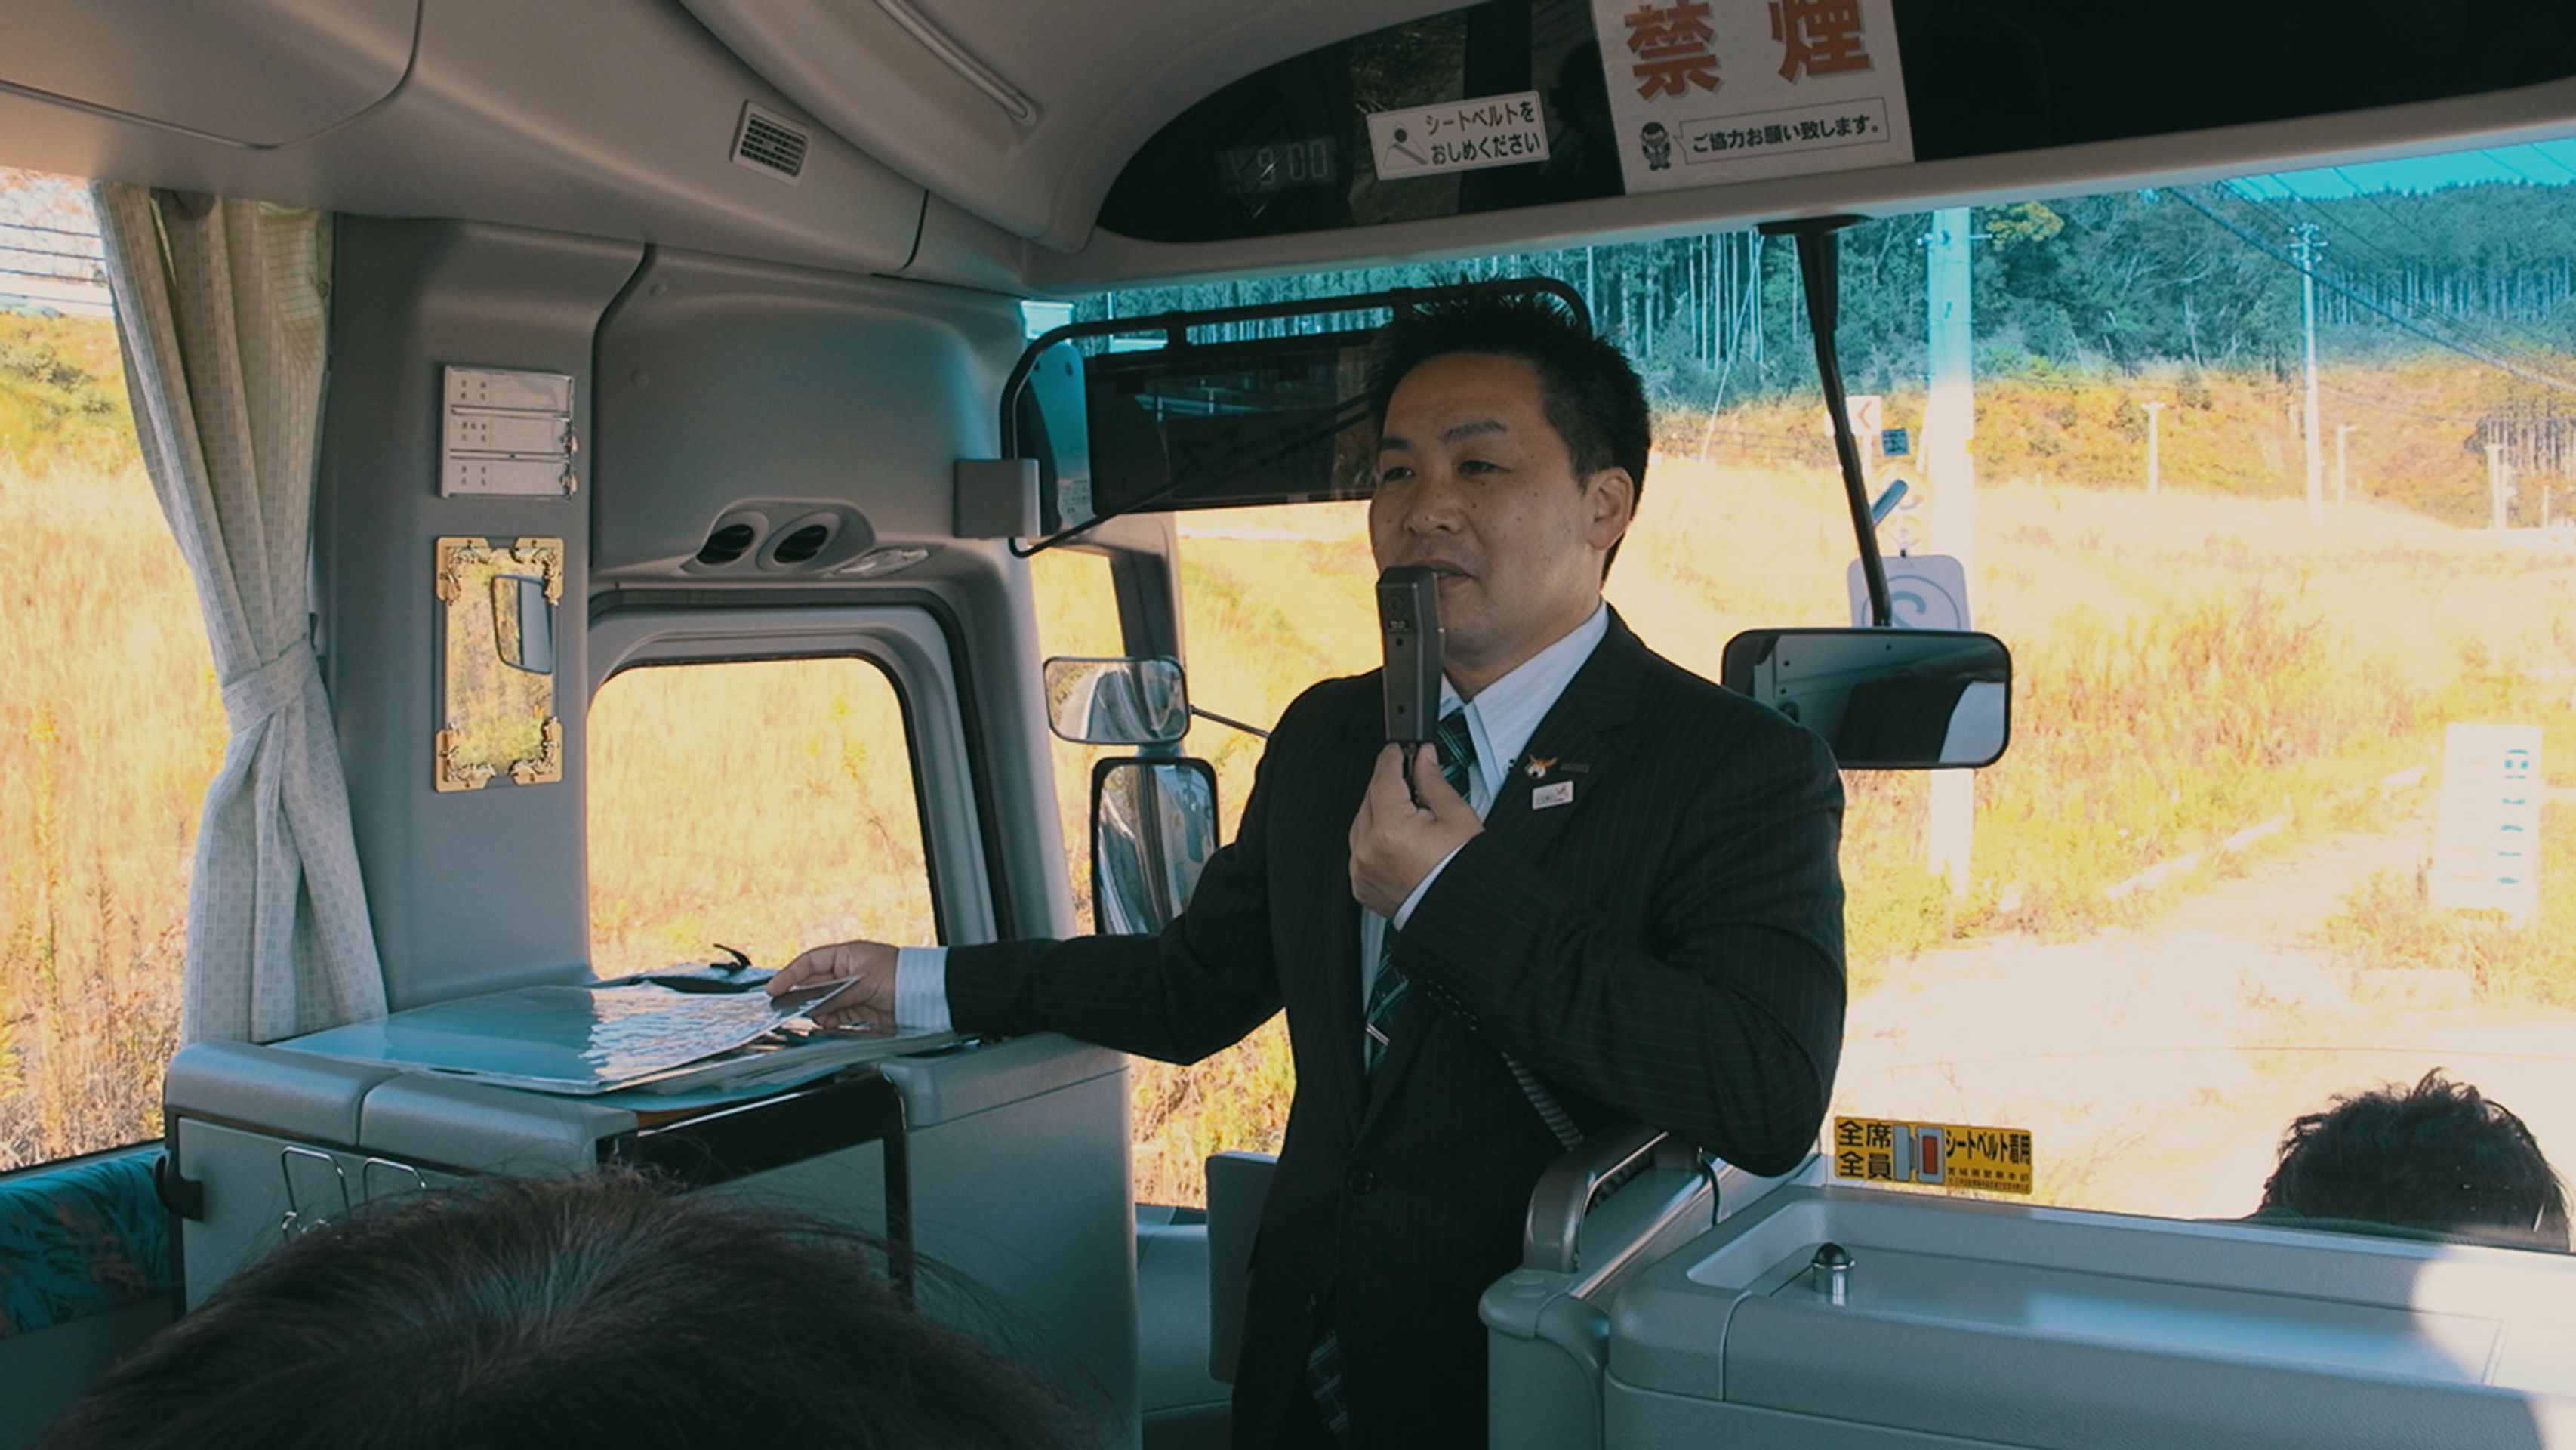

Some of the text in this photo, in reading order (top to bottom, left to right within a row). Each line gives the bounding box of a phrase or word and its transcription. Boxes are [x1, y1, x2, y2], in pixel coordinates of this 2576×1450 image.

[1426, 100, 1535, 136] シートベルトを
[1693, 113, 1879, 153] ご協力お願い致します。
[1431, 132, 1541, 165] おしめください
[1838, 1120, 1891, 1149] 全席
[1946, 1130, 2030, 1165] シートベルト着用
[1838, 1150, 1892, 1180] 全員
